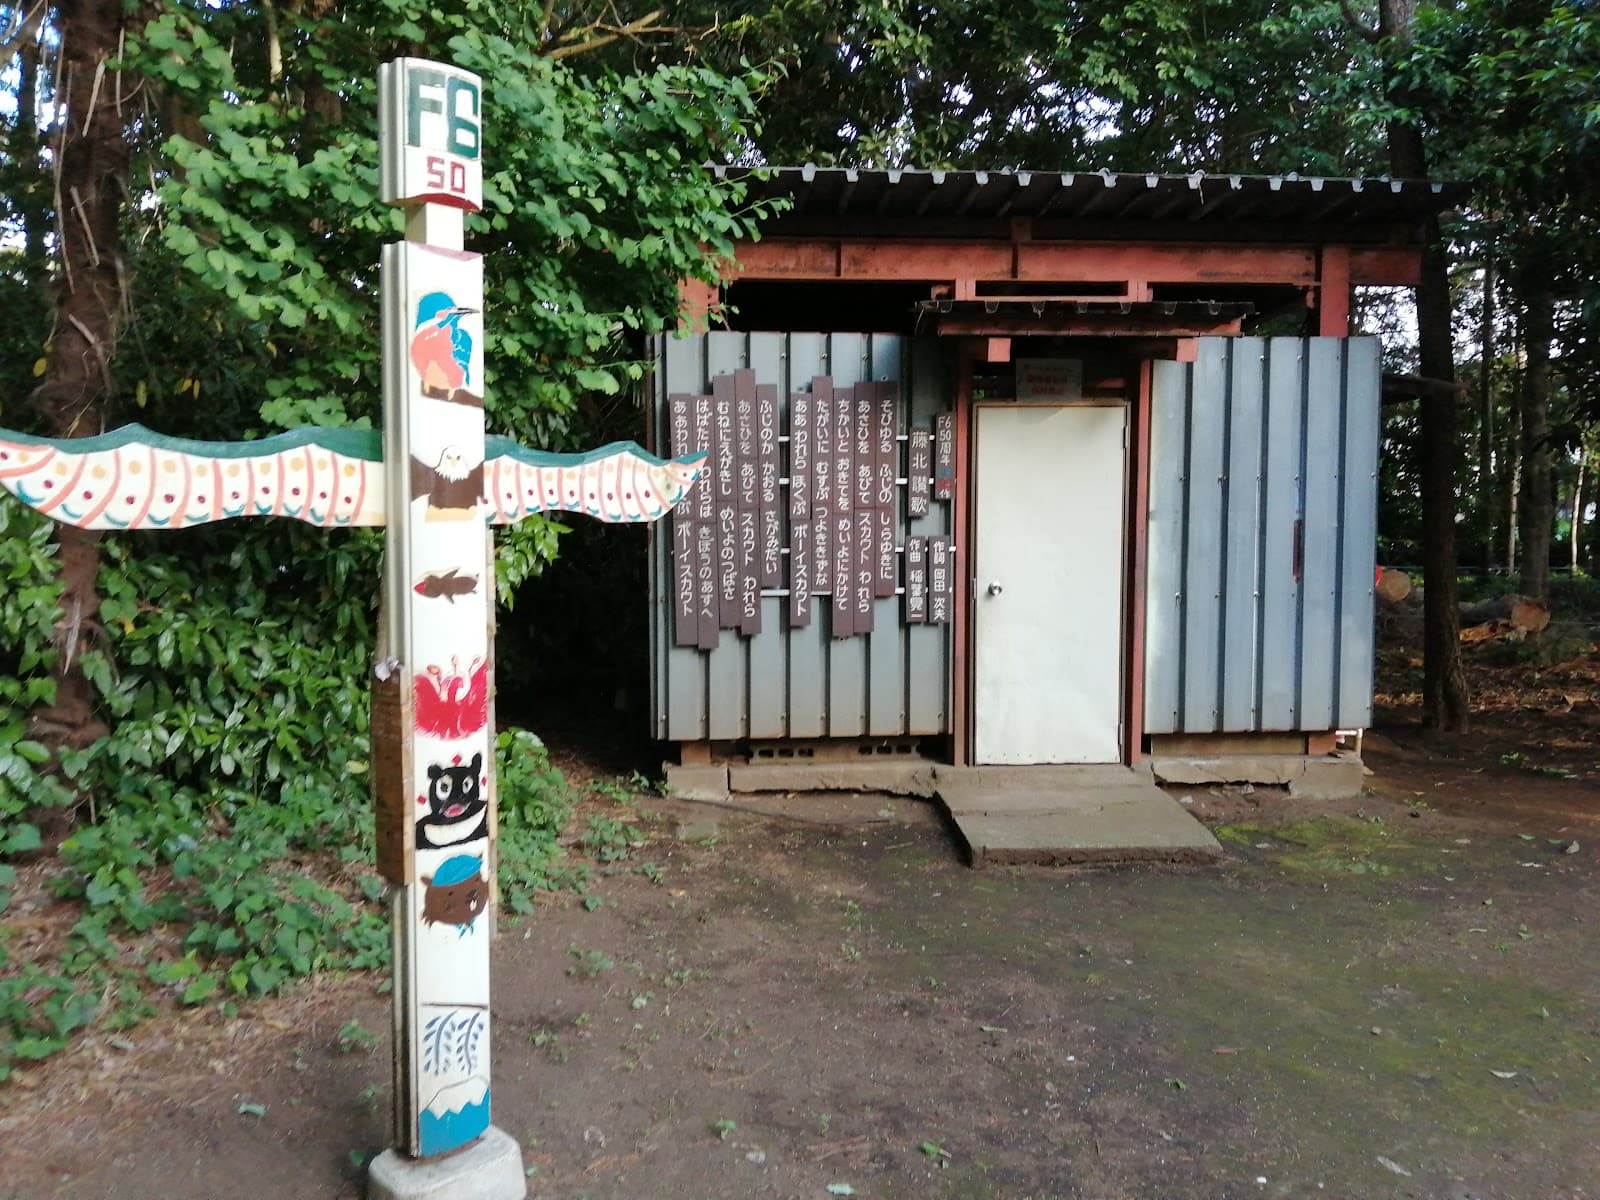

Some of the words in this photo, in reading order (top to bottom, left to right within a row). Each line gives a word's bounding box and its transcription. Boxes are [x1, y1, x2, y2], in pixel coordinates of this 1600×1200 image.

[407, 67, 479, 160] F6
[717, 401, 732, 495] むねにえがきし
[760, 400, 774, 455] ふじのか
[817, 399, 829, 453] たがいに
[838, 399, 850, 453] ちかいと
[858, 400, 870, 454] あさひを
[880, 400, 893, 453] そびゆる
[699, 466, 712, 518] われらは
[741, 463, 755, 502] あびて
[763, 461, 775, 502] かおる
[816, 462, 830, 500] むすぶ
[879, 464, 892, 503] ふじの
[742, 513, 754, 566] スカウト
[765, 511, 779, 574] さがみだい
[815, 507, 828, 585] つよききずな
[836, 519, 851, 610] めいよにかけて
[859, 513, 871, 564] スカウト
[880, 512, 893, 580] しらゆきに
[909, 539, 920, 562] 作曲
[677, 522, 693, 616] ボーイスカウト
[699, 526, 714, 618] きぼうのあすへ
[794, 524, 808, 617] ボーイスカウト
[858, 571, 871, 613] われら
[743, 576, 757, 618] われら
